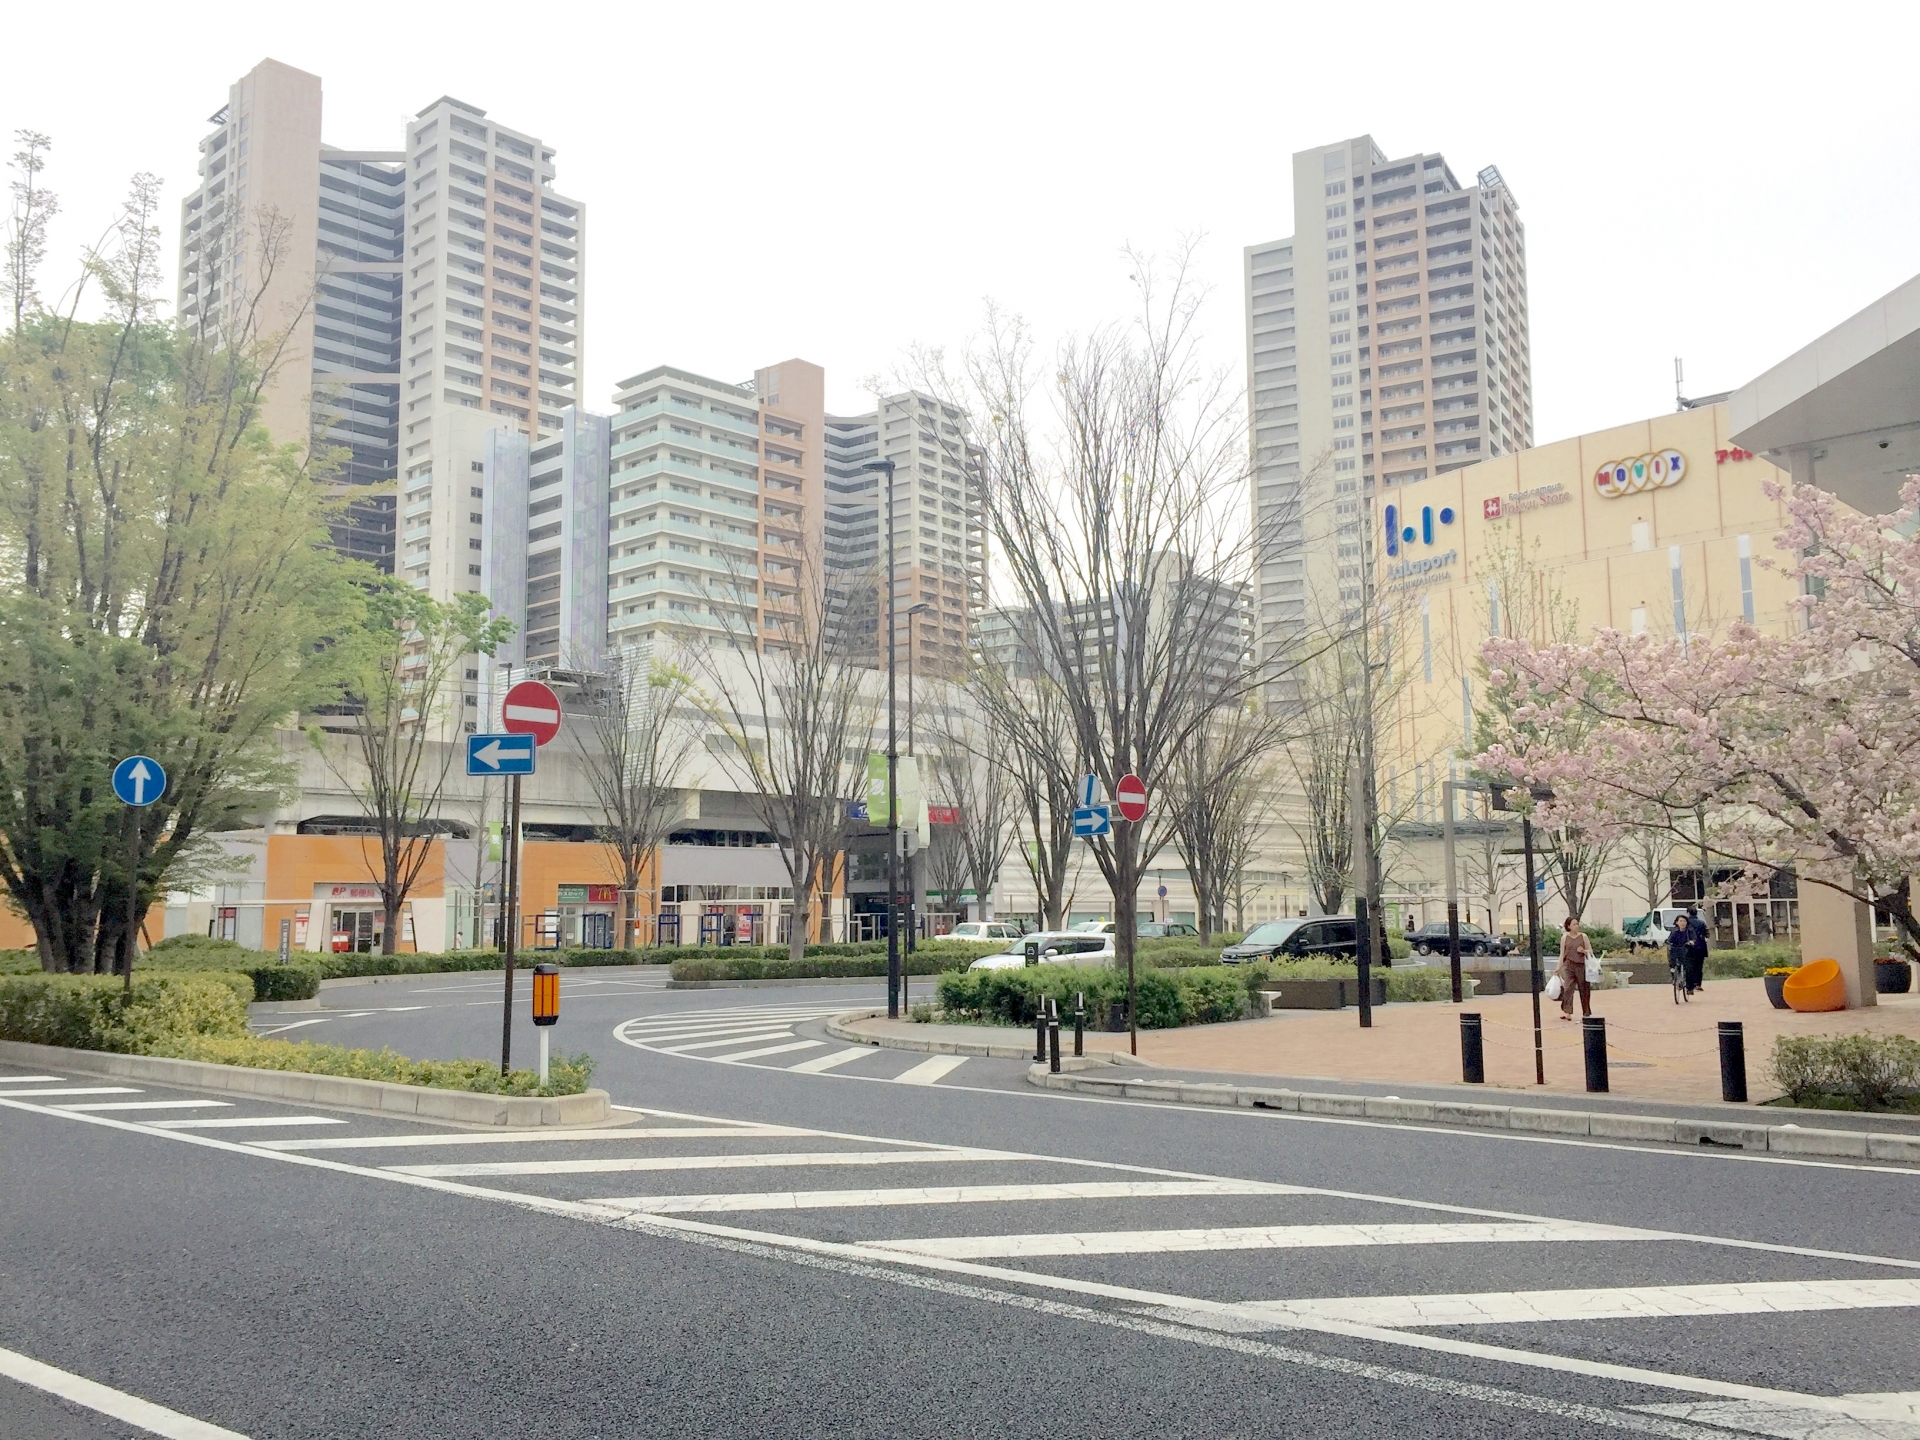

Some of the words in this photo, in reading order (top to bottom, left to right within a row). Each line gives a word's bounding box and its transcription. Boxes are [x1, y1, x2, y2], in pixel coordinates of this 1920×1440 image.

[1597, 455, 1681, 486] MOVIX
[1502, 499, 1538, 515] Tokyu
[1539, 491, 1571, 506] Store
[1508, 490, 1529, 502] Food
[1530, 482, 1563, 497] campus
[1387, 548, 1457, 580] LaLaport
